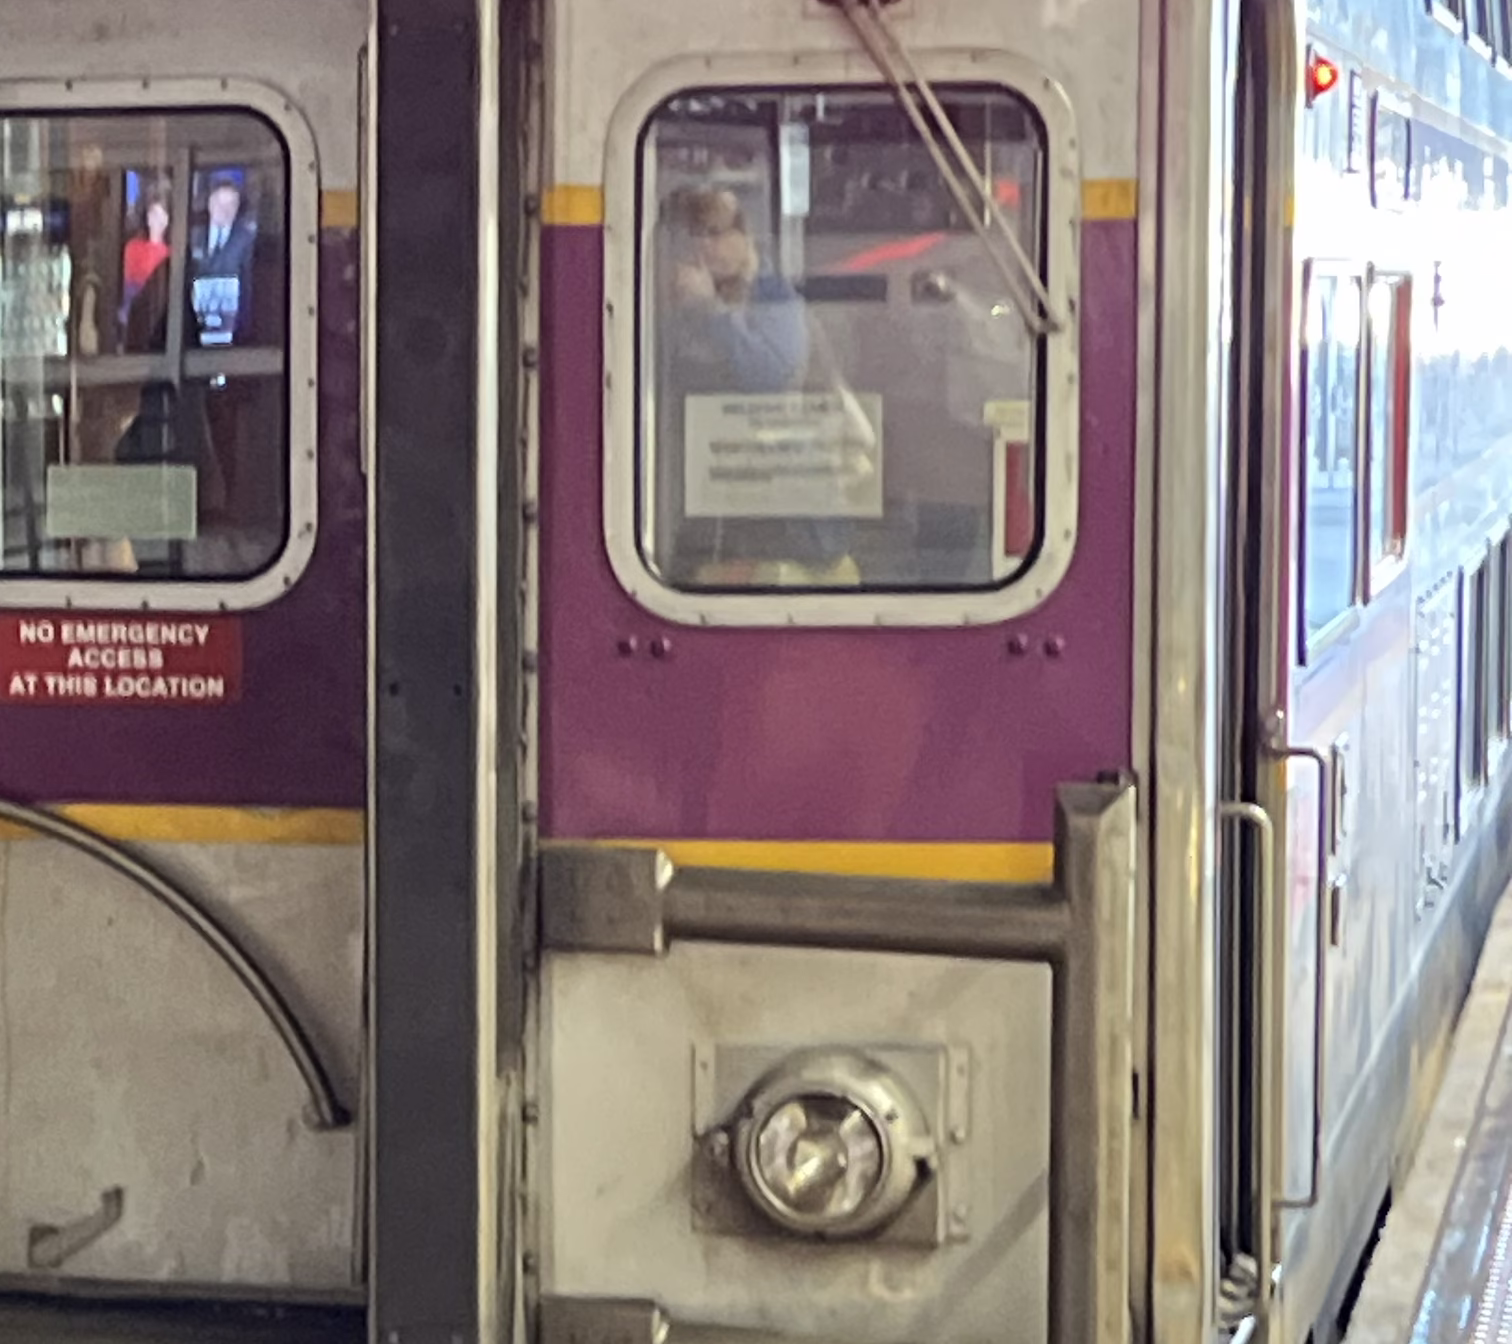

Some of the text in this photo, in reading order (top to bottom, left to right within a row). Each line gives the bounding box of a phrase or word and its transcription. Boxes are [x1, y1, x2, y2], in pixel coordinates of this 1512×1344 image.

[19, 619, 209, 646] NO EMERGENCY
[68, 647, 164, 670] ACCESS
[9, 674, 224, 698] AT THIS LOCATION
